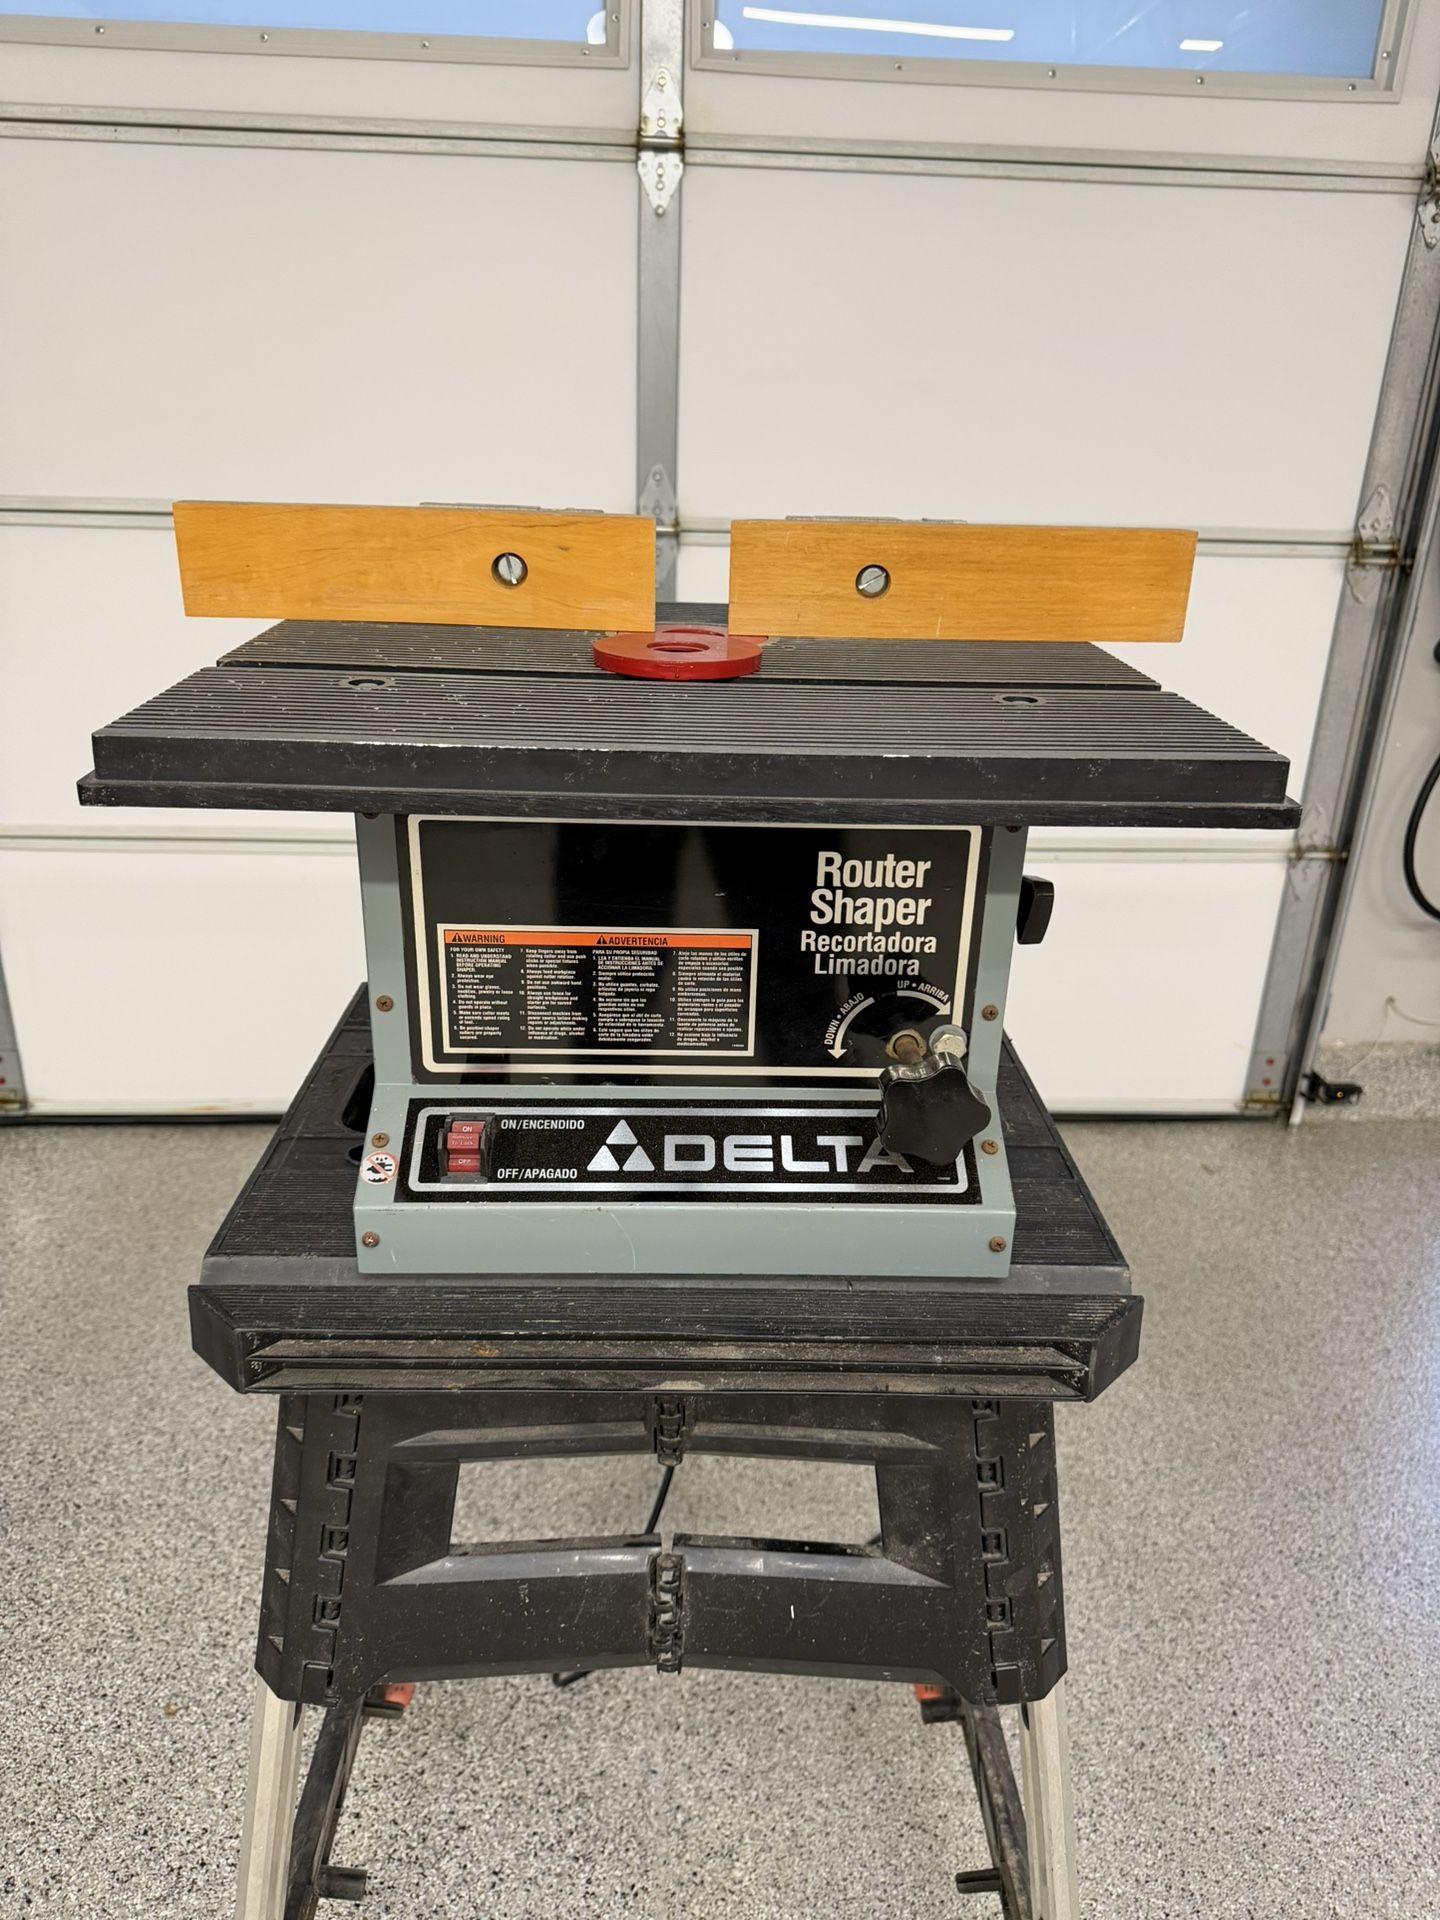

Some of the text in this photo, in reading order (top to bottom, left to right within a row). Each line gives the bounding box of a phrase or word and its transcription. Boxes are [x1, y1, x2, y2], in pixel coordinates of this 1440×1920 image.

[816, 851, 931, 888] Router
[810, 889, 932, 932] Shaper
[463, 934, 505, 943] WARNING
[609, 937, 667, 945] ADVERTENCIA
[800, 930, 937, 953] Recortadora
[814, 954, 920, 976] Limadora
[897, 980, 949, 1003] UP ARRIBA
[824, 992, 865, 1044] DOWN ABAJO
[501, 1119, 585, 1130] ON/ENCENDIDO
[664, 1134, 915, 1174] DELTA
[497, 1168, 578, 1179] OFF/APAGADO
